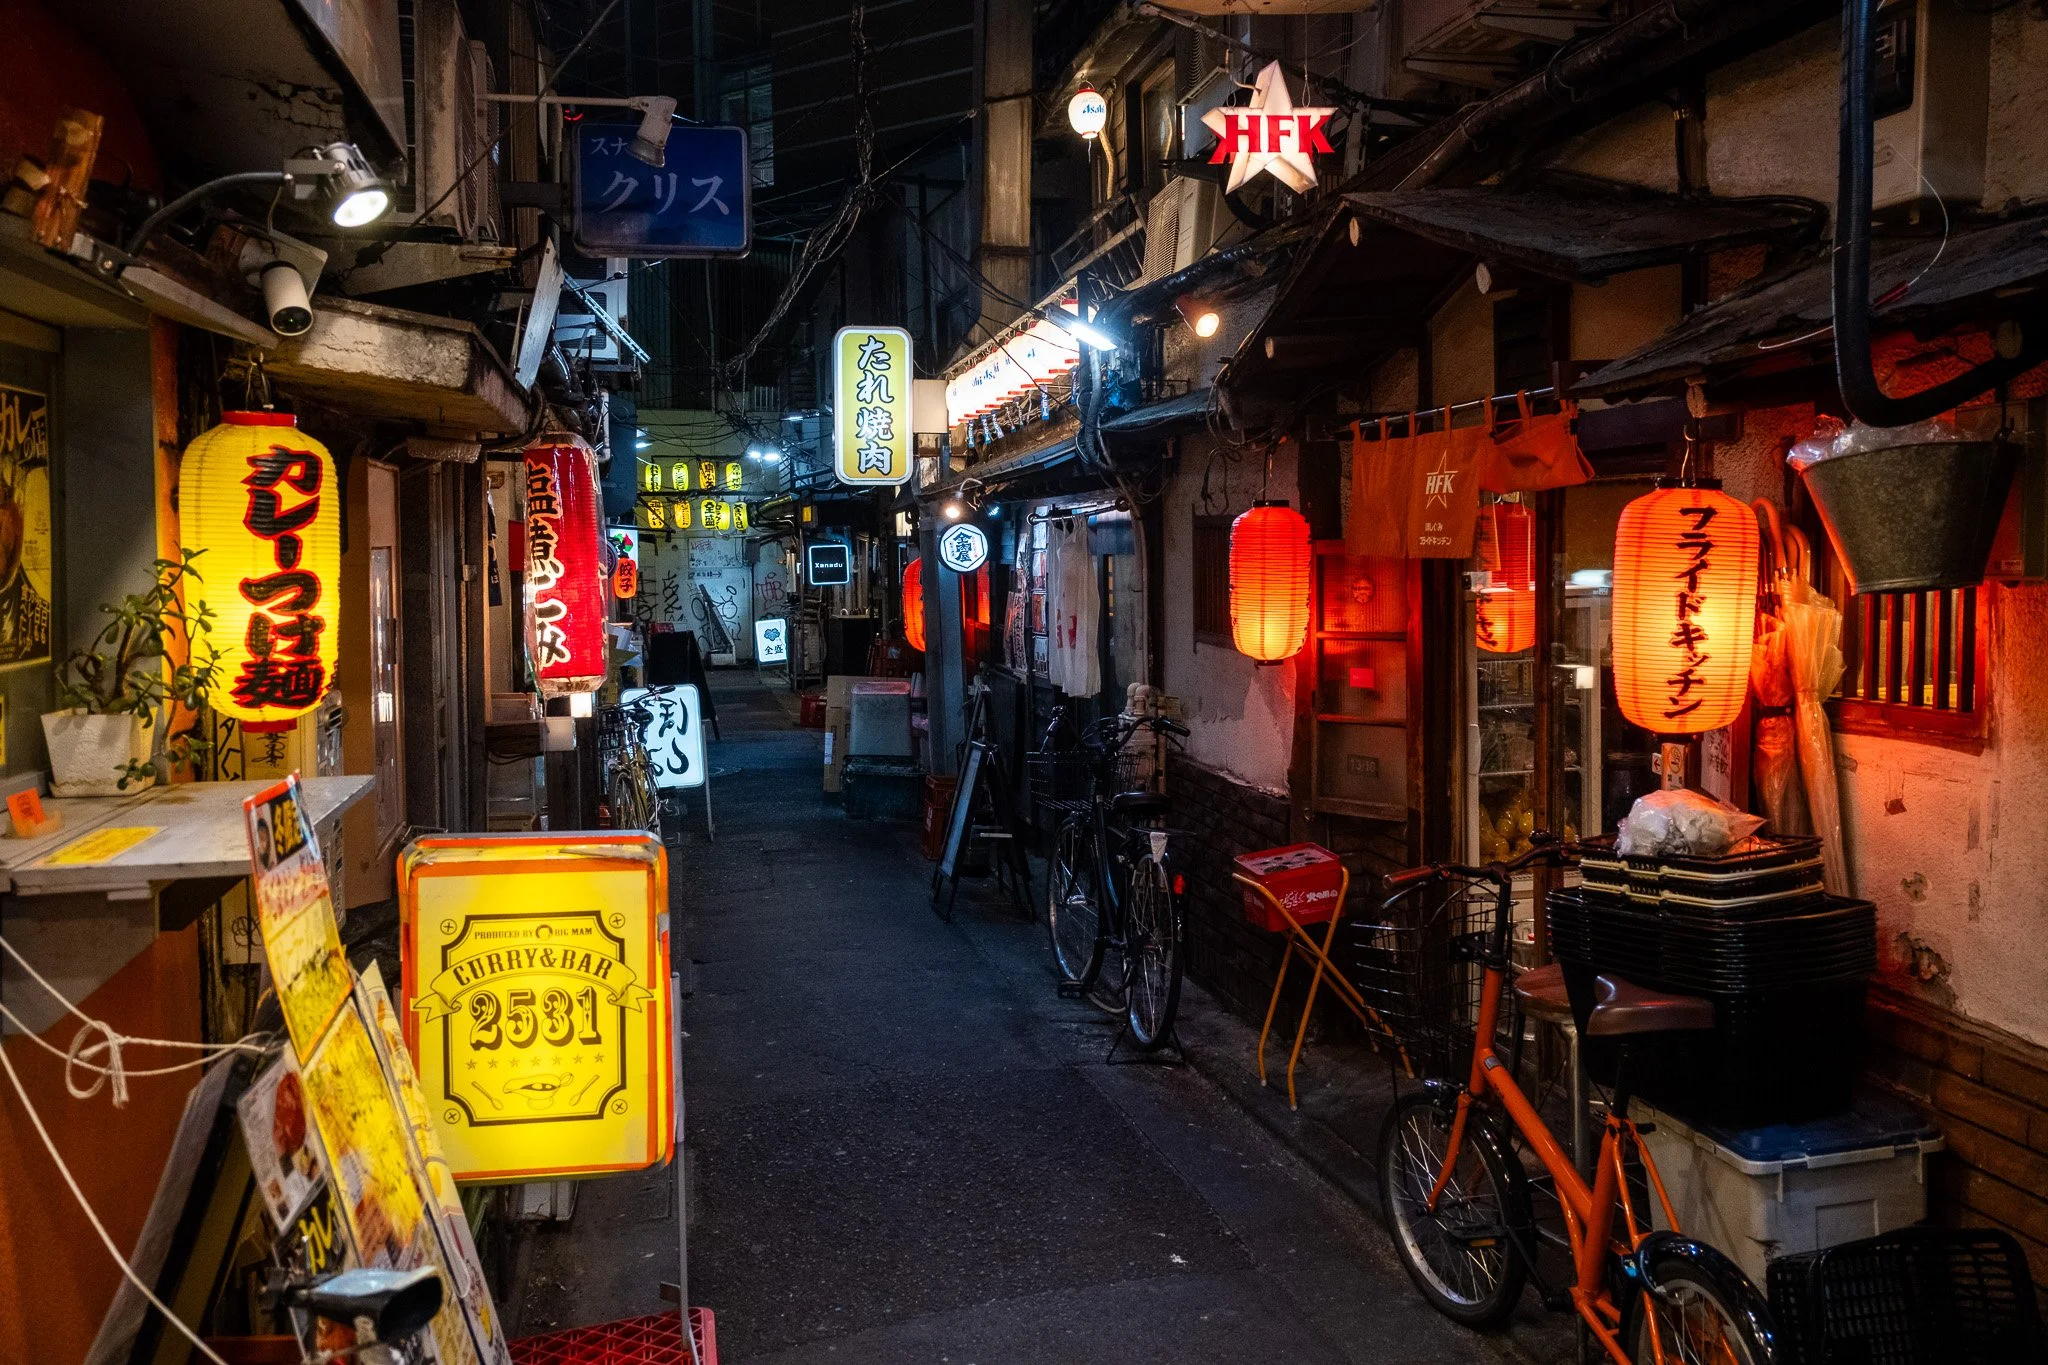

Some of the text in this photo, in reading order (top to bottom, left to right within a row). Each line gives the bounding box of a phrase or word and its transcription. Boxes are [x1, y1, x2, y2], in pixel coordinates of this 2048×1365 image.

[590, 136, 631, 156] スナ
[1211, 114, 1335, 160] HFK
[598, 170, 731, 216] クリス
[855, 335, 895, 476] たれ焼肉
[1425, 474, 1455, 495] HFK
[229, 443, 326, 710] カレーつけ麺
[619, 561, 633, 593] 餃子
[1663, 506, 1719, 720] フライドキッチン
[474, 930, 520, 941] PRODUCED
[522, 929, 534, 939] BY
[571, 927, 593, 936] MAM
[452, 946, 614, 987] CURRY&BAR
[469, 985, 602, 1052] 2531
